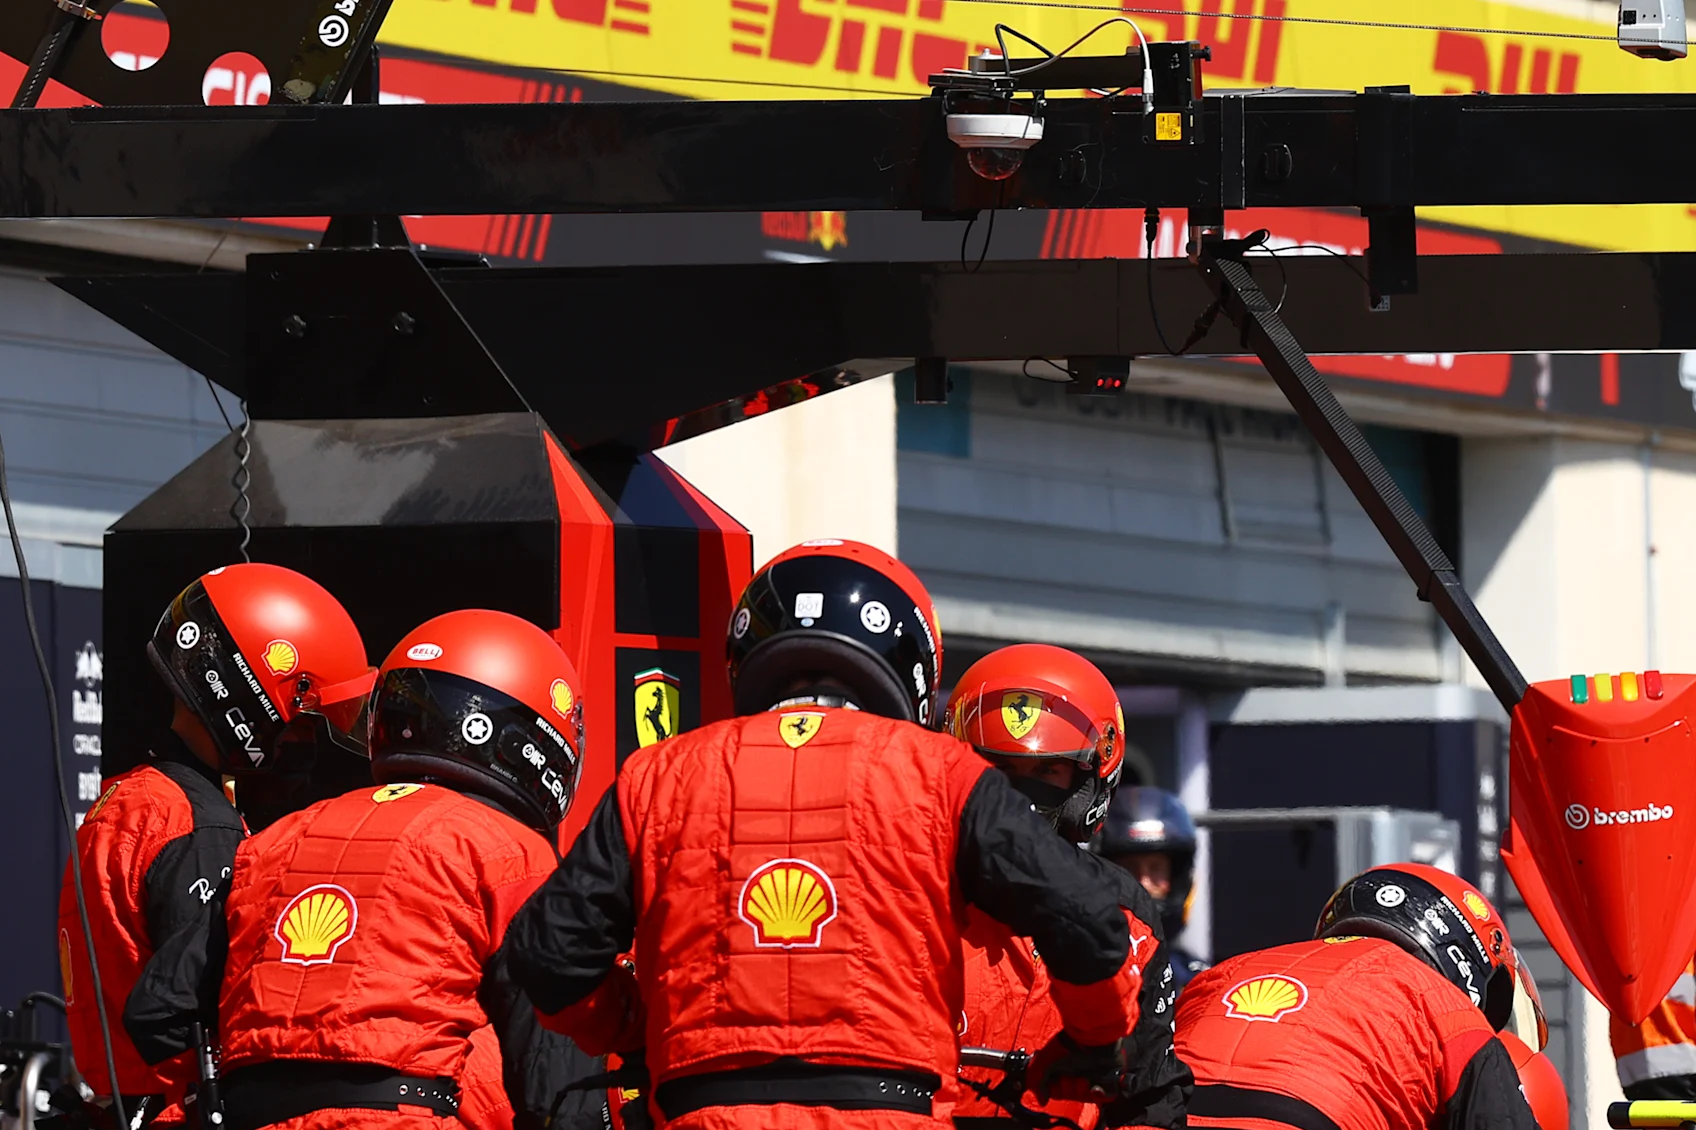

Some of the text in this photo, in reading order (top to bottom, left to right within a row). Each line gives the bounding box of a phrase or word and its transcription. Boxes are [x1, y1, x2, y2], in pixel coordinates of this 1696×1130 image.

[233, 652, 280, 722] RICHARD MILLE
[1594, 803, 1674, 825] brembo
[1470, 934, 1489, 964] MILLE
